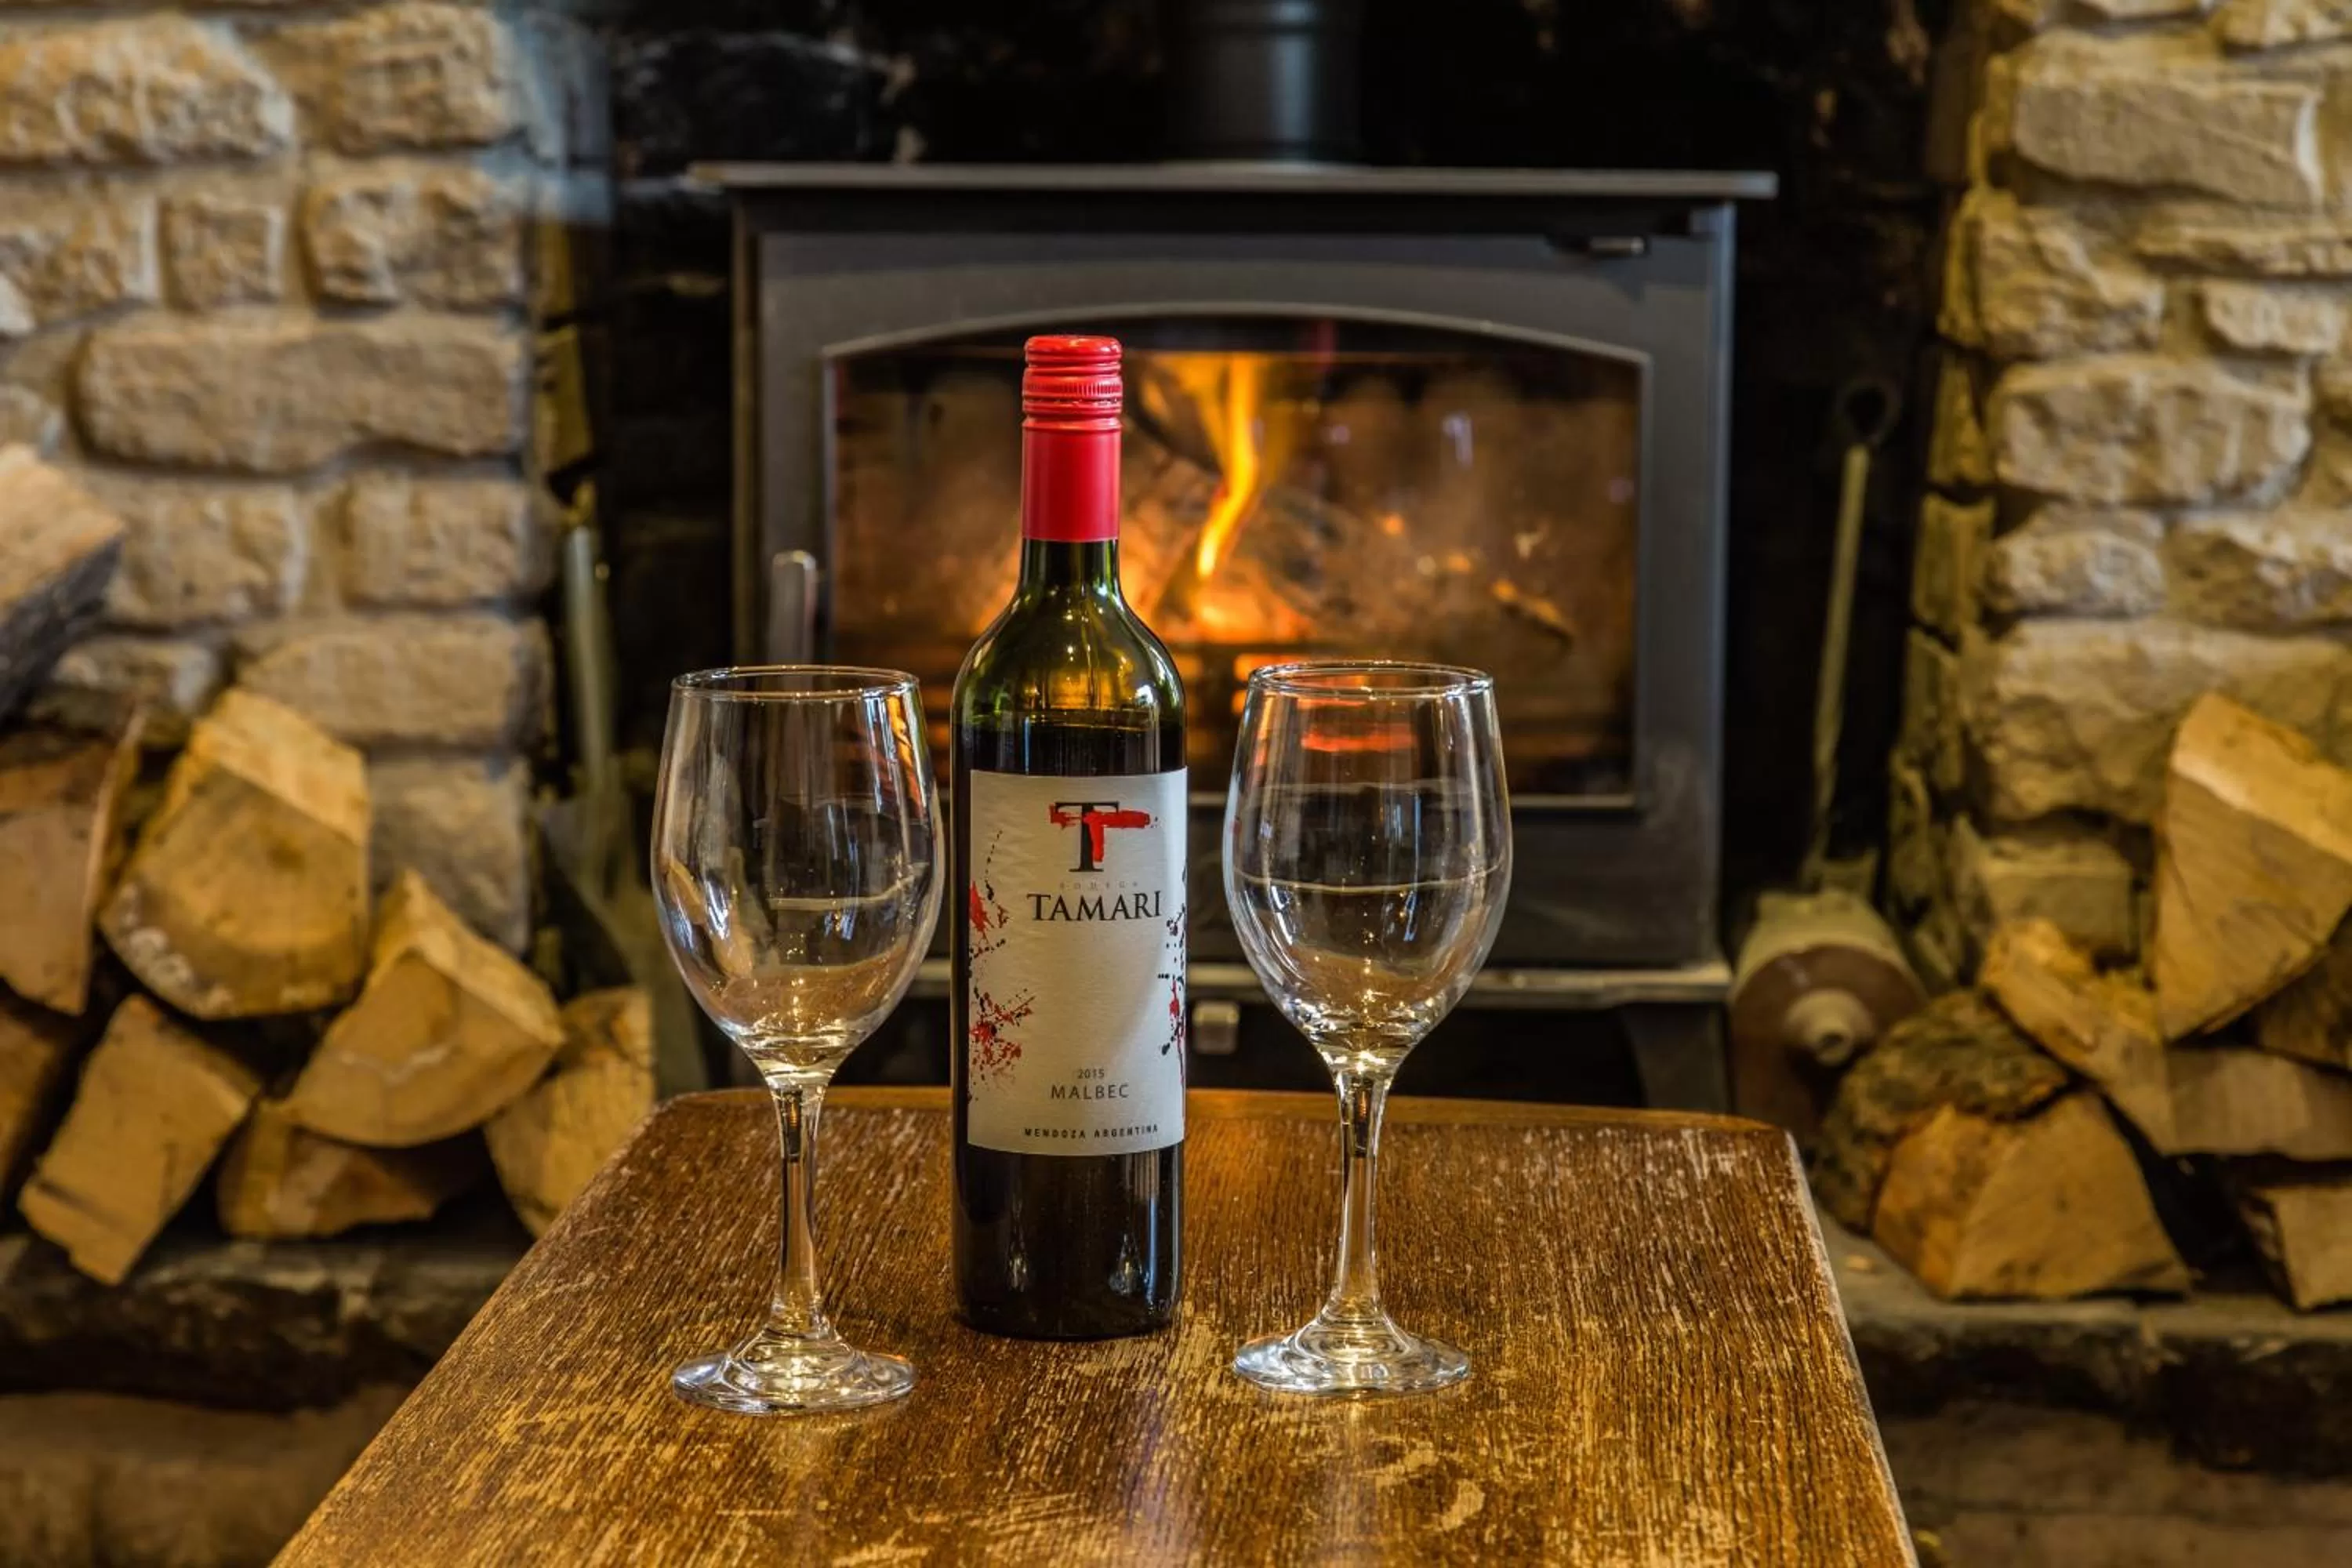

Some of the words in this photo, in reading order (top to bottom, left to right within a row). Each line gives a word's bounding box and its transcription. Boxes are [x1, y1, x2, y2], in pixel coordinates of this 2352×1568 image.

[1054, 800, 1120, 873] T
[1026, 891, 1161, 921] TAMARI
[1077, 1069, 1105, 1079] 2015
[1051, 1084, 1129, 1099] MALBEC
[1024, 1127, 1086, 1138] MENDOZA
[1094, 1123, 1158, 1138] ARGENTINA
